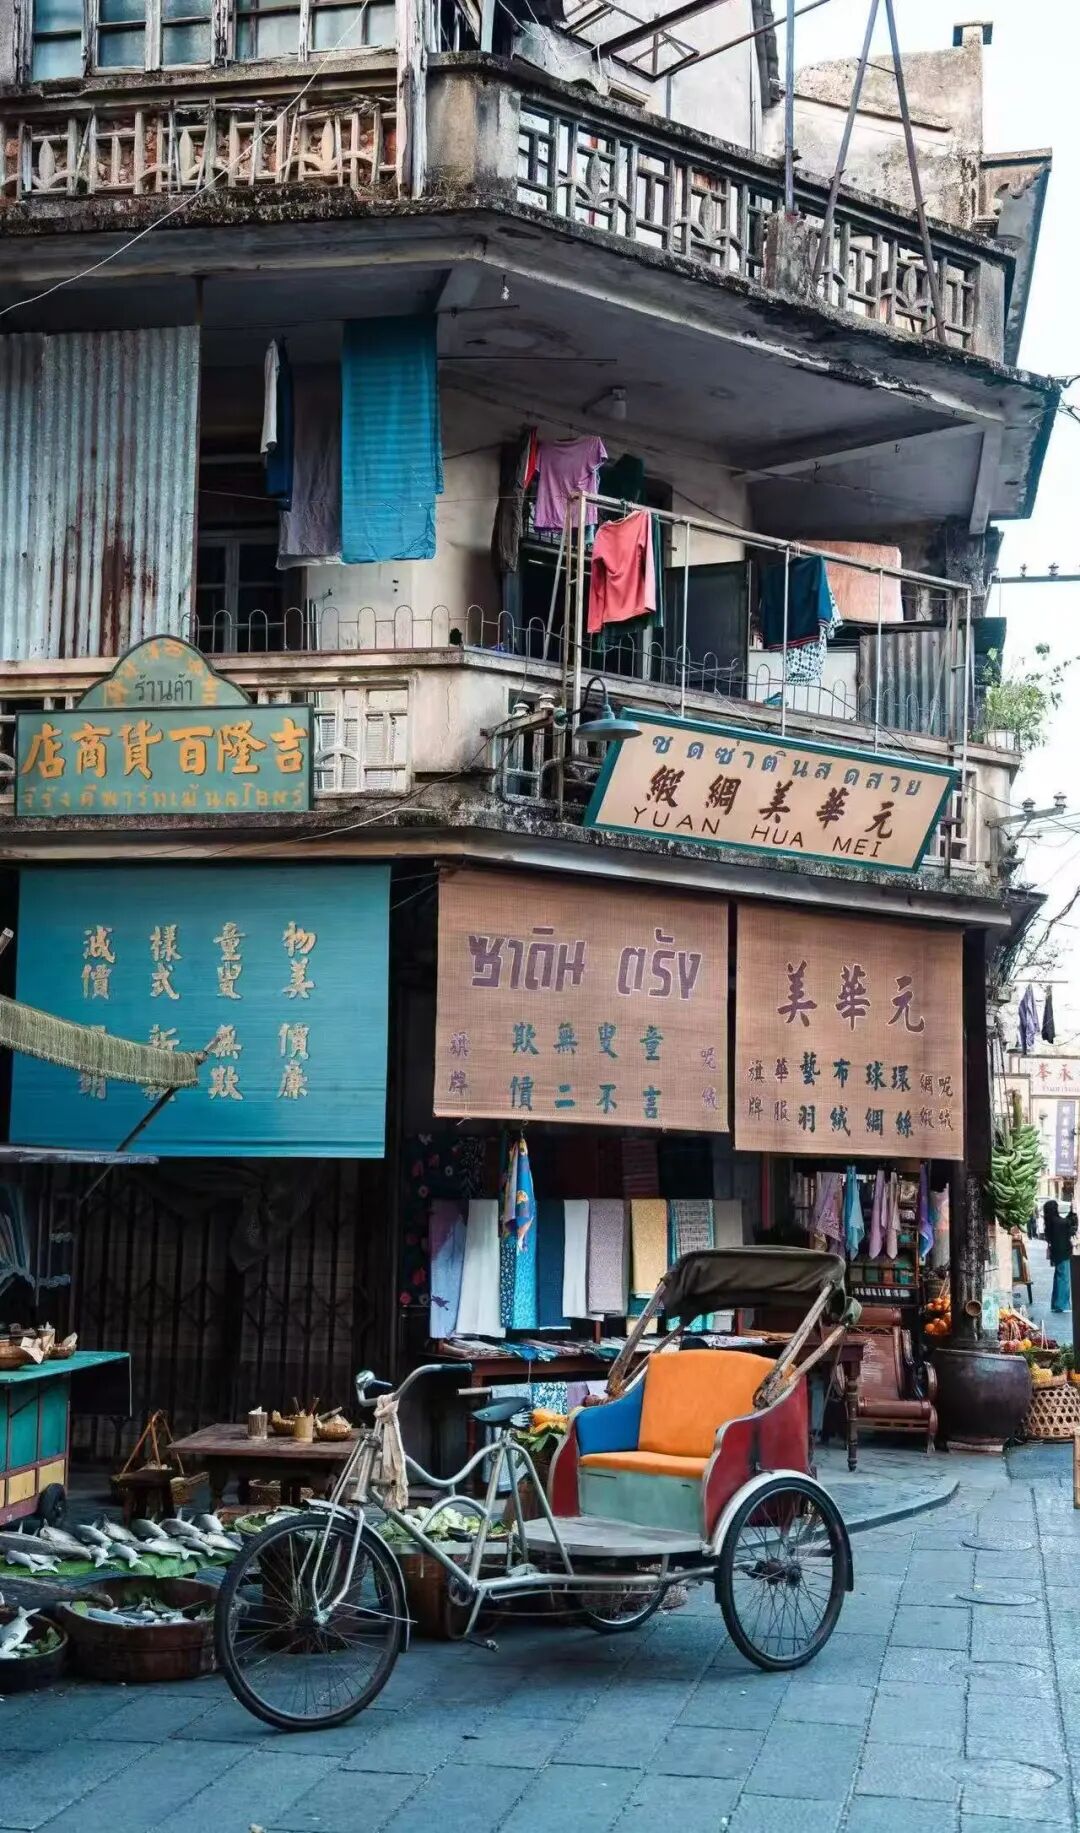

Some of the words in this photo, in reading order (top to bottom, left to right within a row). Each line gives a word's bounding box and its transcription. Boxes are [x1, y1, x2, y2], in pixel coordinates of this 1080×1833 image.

[134, 673, 193, 702] ร้านค้า
[21, 717, 308, 780] 吉隆百貨商店
[632, 806, 721, 835] YUAN
[750, 823, 804, 849] HUA
[831, 836, 884, 859] MEI
[616, 927, 703, 1001] ตรัง
[776, 959, 926, 1034] 元華美
[277, 920, 318, 1101] 物美價廉
